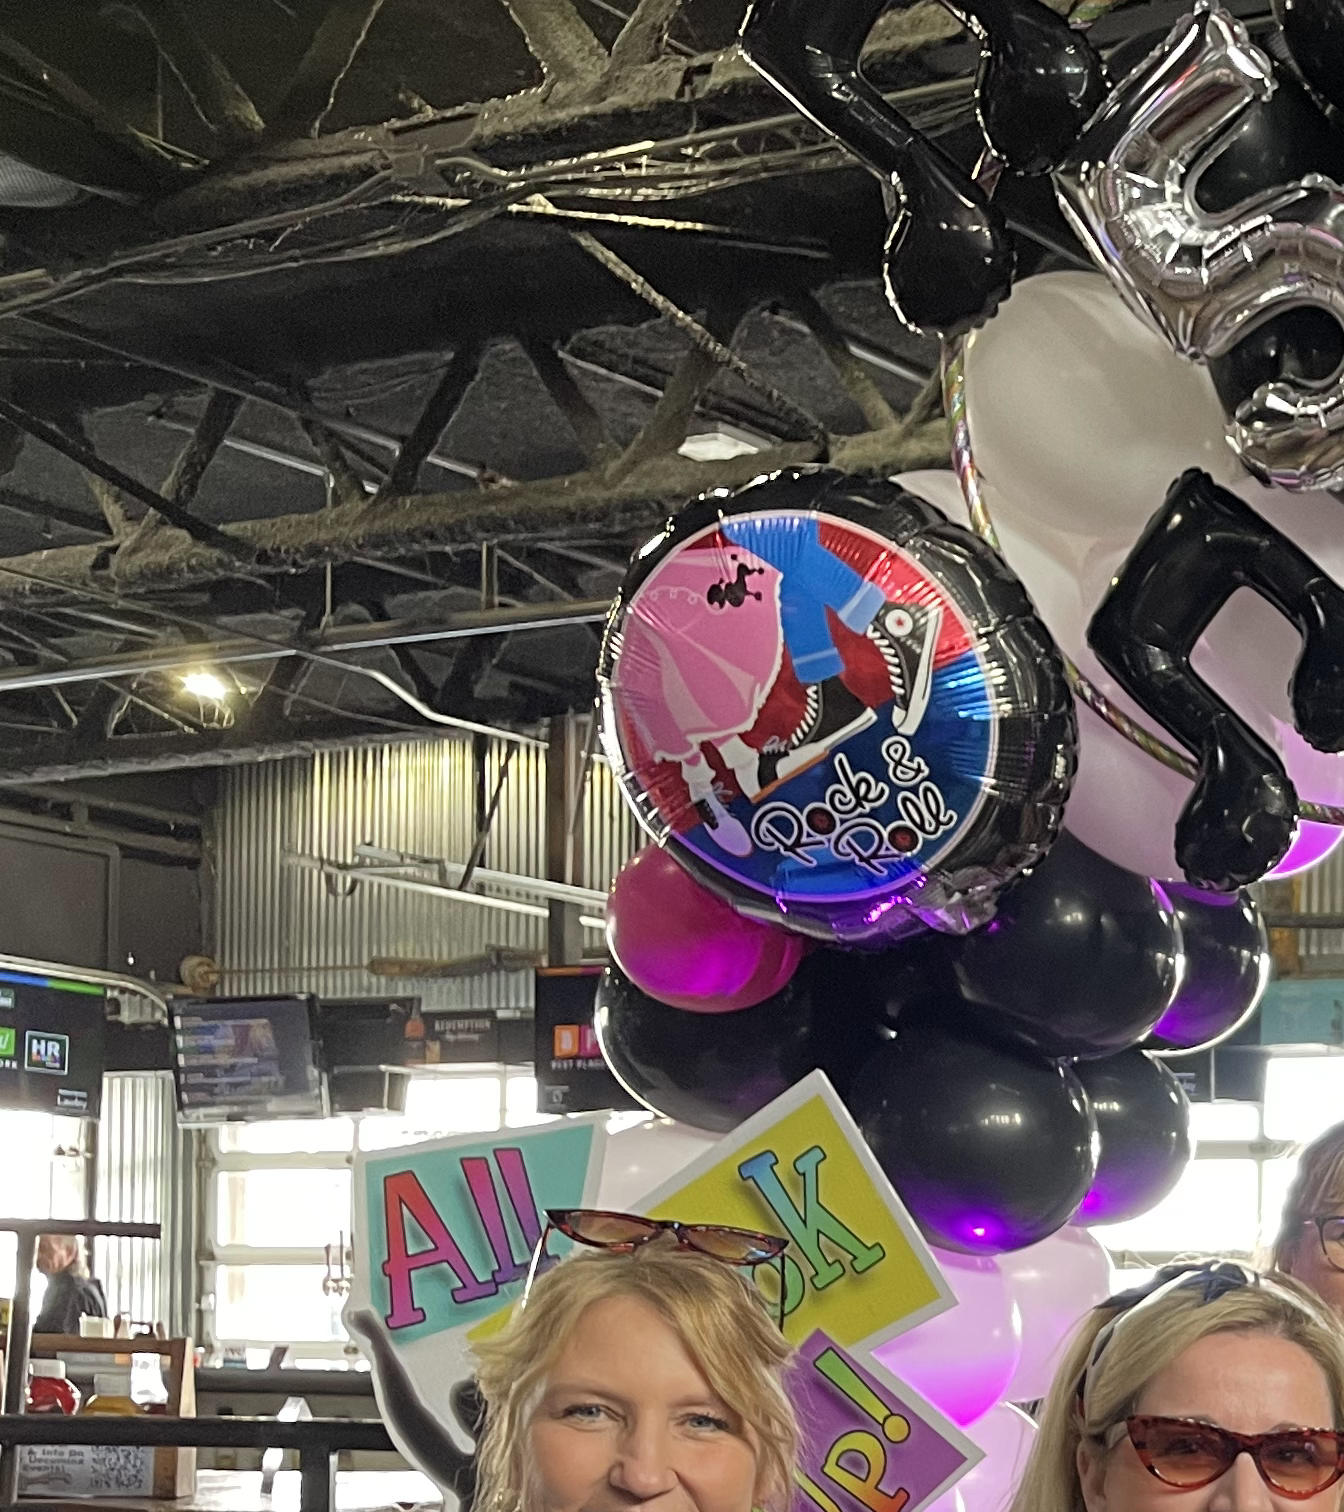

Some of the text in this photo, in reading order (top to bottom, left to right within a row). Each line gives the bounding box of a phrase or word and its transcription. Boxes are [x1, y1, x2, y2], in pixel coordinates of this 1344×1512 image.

[753, 734, 929, 867] Rock &
[832, 782, 959, 876] Roll
[31, 1039, 61, 1056] HR
